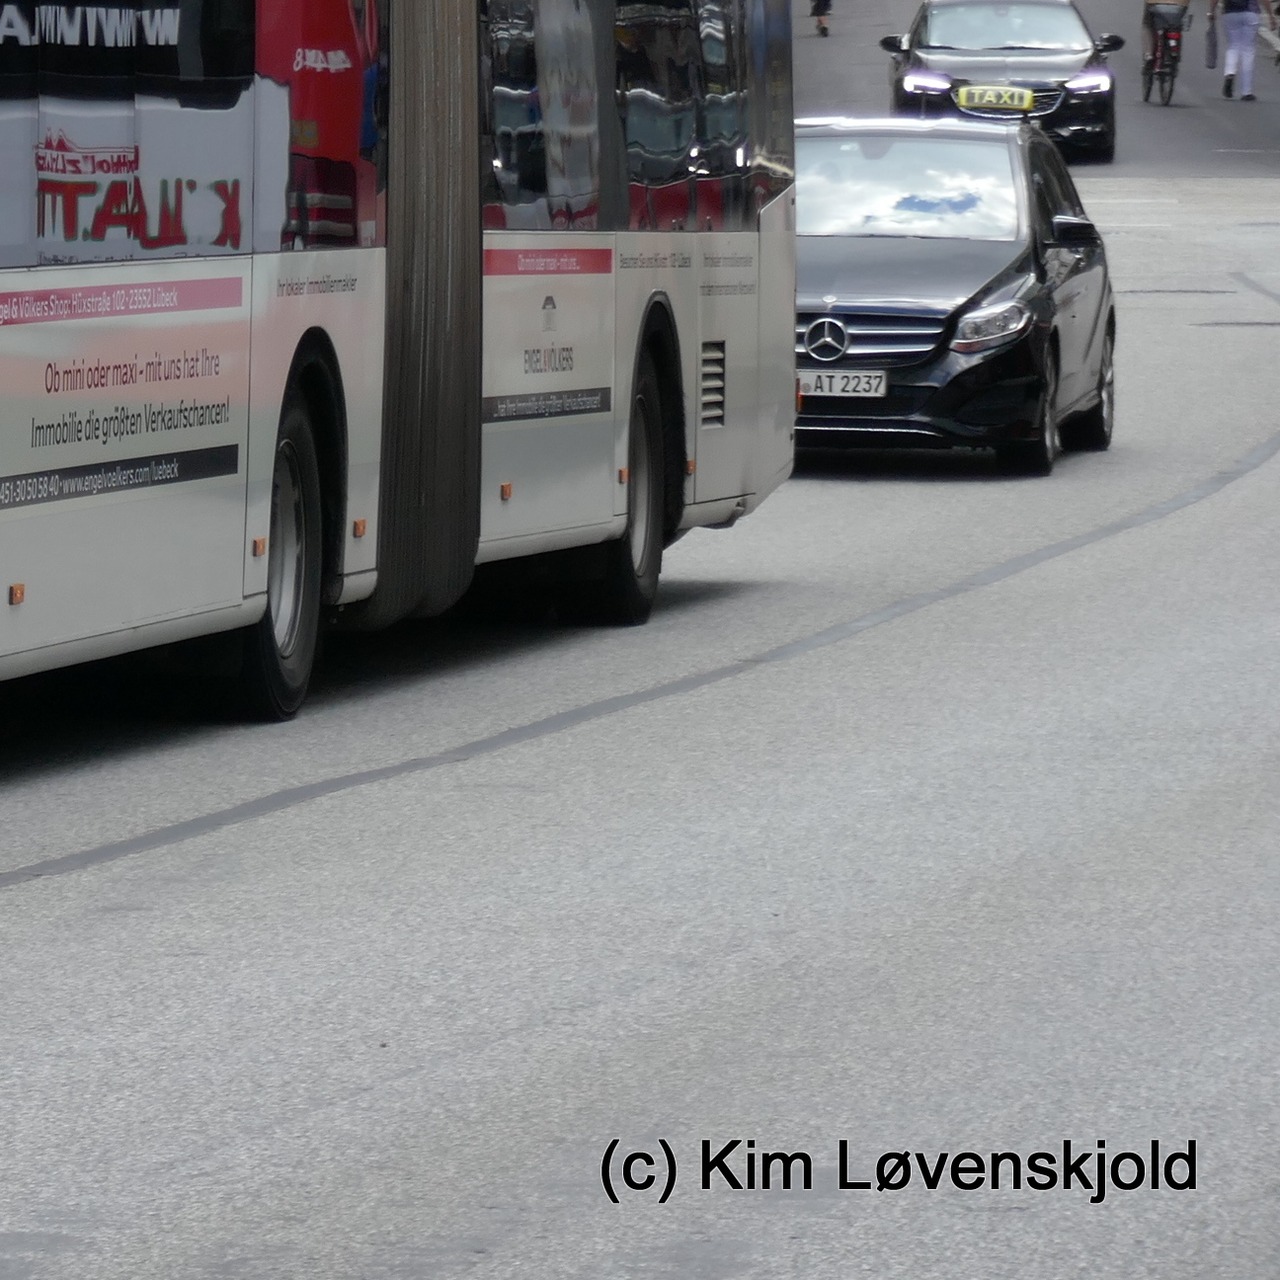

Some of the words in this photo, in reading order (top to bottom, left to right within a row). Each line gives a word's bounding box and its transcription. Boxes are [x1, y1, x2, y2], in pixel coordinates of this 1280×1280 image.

[971, 89, 1020, 105] TAXI
[19, 295, 48, 319] Völkers
[153, 286, 178, 308] Lübeck
[44, 361, 60, 394] Ob
[62, 359, 85, 392] mini
[86, 358, 111, 390] oder
[112, 353, 138, 386] maxi
[145, 351, 162, 383] mit
[163, 357, 181, 380] uns
[183, 350, 200, 379] hat
[201, 348, 220, 377] Ihre
[813, 374, 836, 393] AT
[840, 374, 884, 394] 2237
[31, 410, 82, 448] Immobilie
[84, 408, 100, 442] die
[101, 406, 142, 445] größten
[144, 394, 230, 433] Verkaufschancen!
